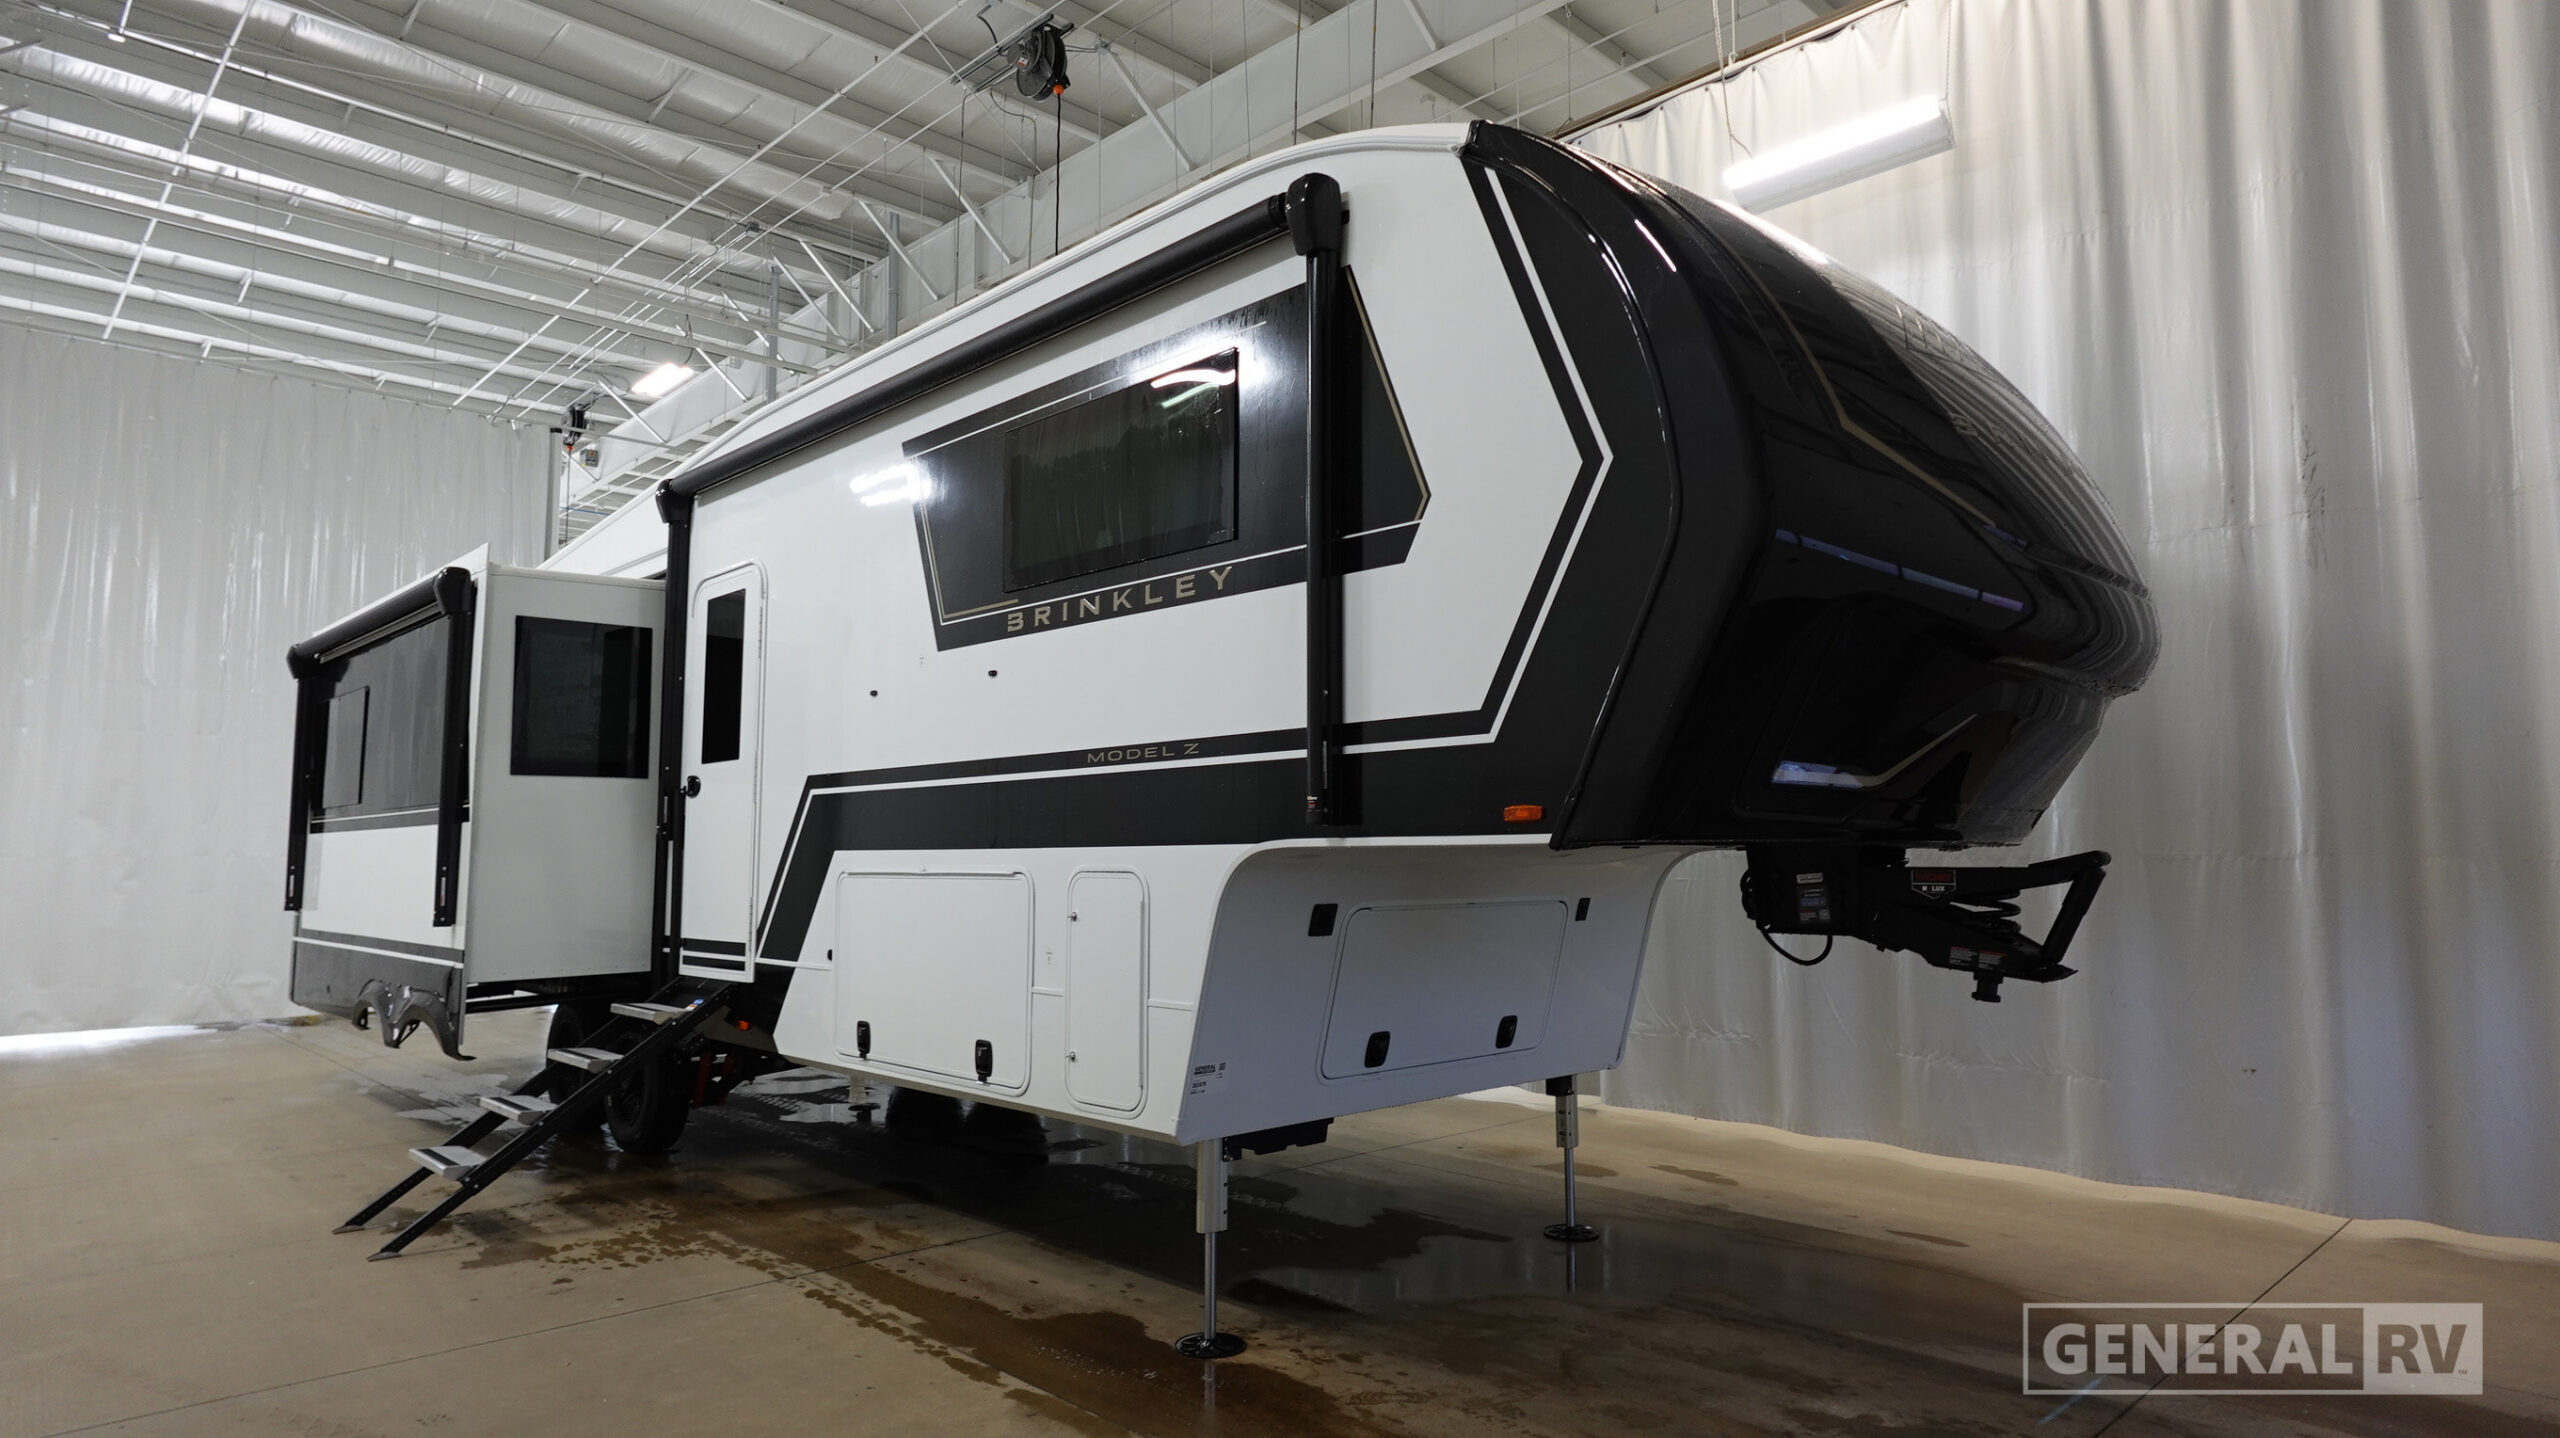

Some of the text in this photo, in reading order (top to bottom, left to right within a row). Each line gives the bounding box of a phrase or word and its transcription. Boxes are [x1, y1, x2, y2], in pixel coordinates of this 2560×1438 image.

[1007, 566, 1233, 632] BRINKLEY
[1087, 743, 1200, 763] MODEL Z
